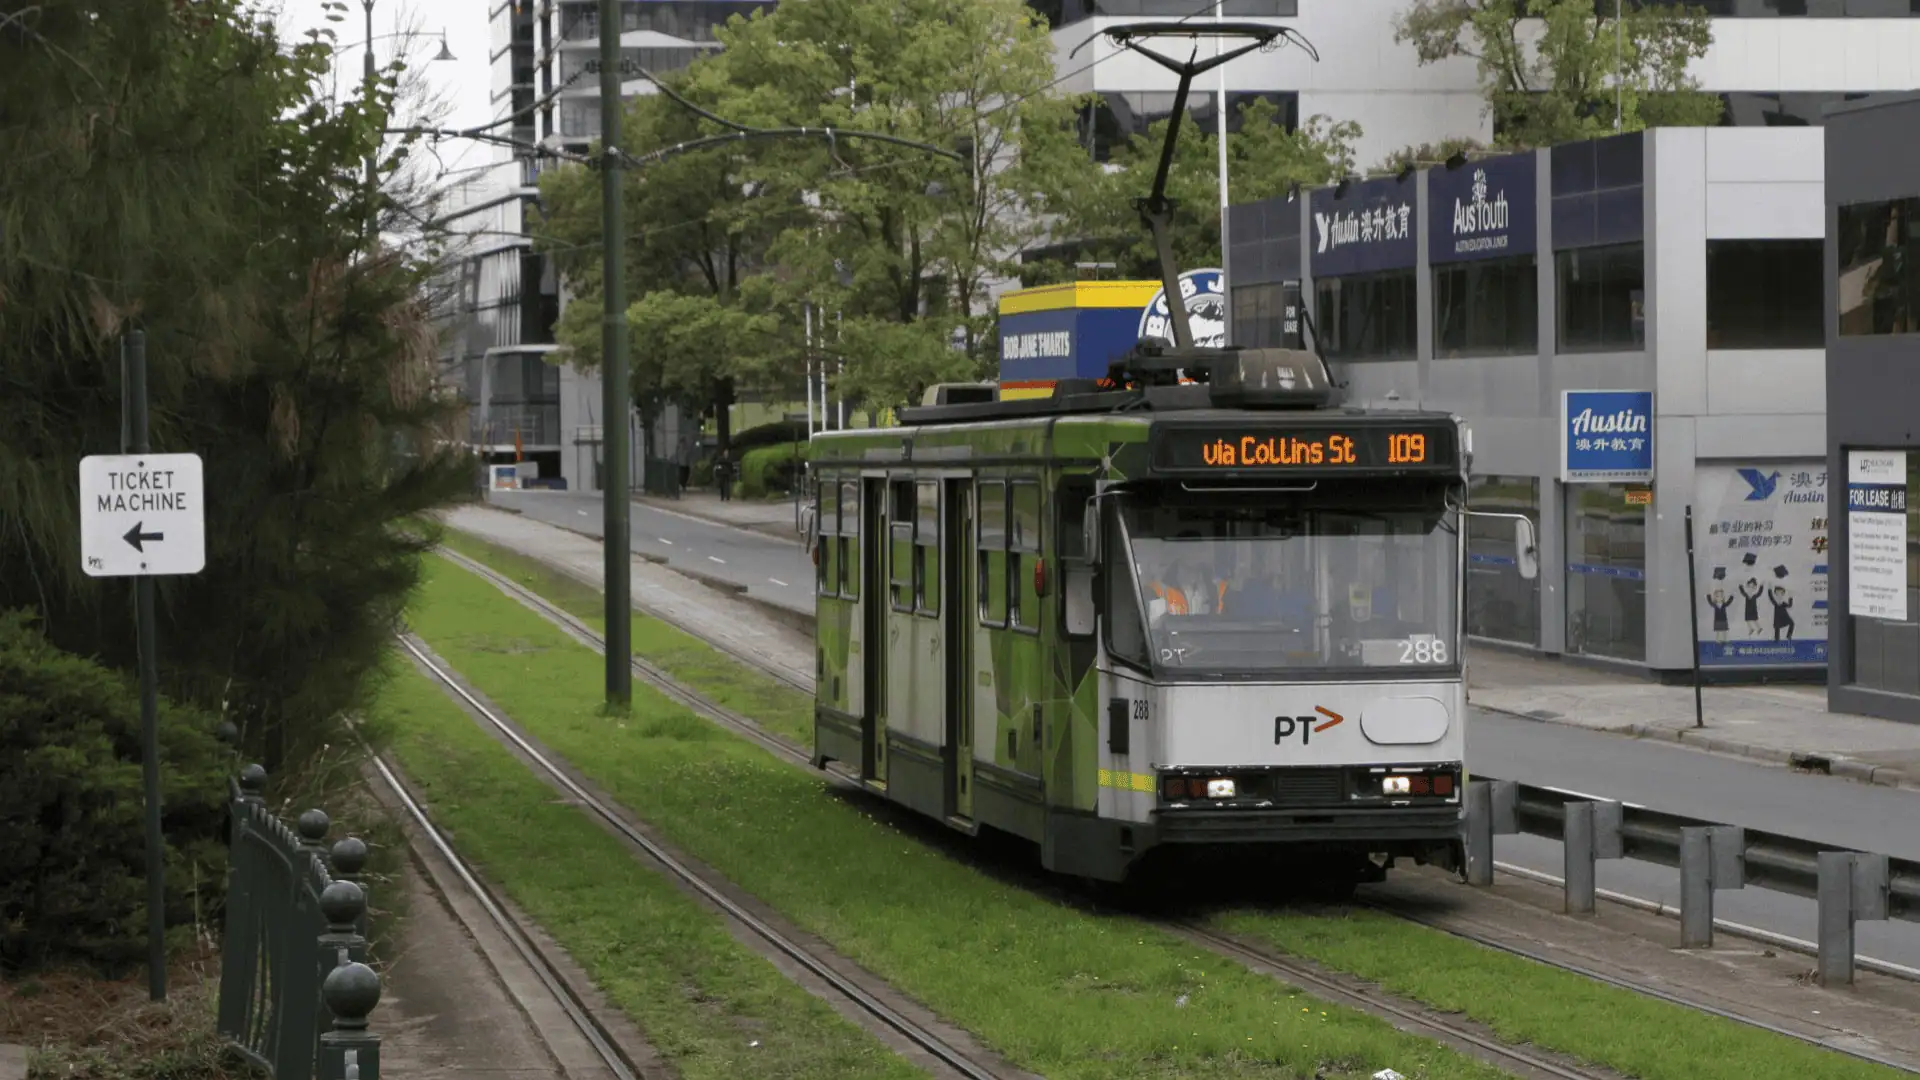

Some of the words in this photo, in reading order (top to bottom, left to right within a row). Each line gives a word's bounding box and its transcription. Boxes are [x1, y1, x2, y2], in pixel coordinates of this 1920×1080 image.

[1331, 210, 1359, 249] Austin
[1361, 200, 1411, 243] 澳升教育
[1285, 305, 1296, 318] FOR
[1284, 320, 1298, 333] LEASE
[1003, 335, 1019, 360] BOB
[1020, 333, 1037, 360] JANE
[1572, 408, 1647, 436] Austin
[1203, 437, 1236, 466] via
[1240, 436, 1324, 466] Collins
[1328, 436, 1356, 464] St
[1387, 434, 1426, 463] 109
[1576, 438, 1645, 451] 澳升教育
[108, 471, 174, 490] TICKET
[97, 492, 187, 512] MACHINE
[1784, 490, 1825, 504] Austin
[1849, 489, 1865, 506] FOR
[1866, 490, 1889, 507] LEASE
[1397, 639, 1449, 664] 288
[1133, 700, 1149, 721] 288
